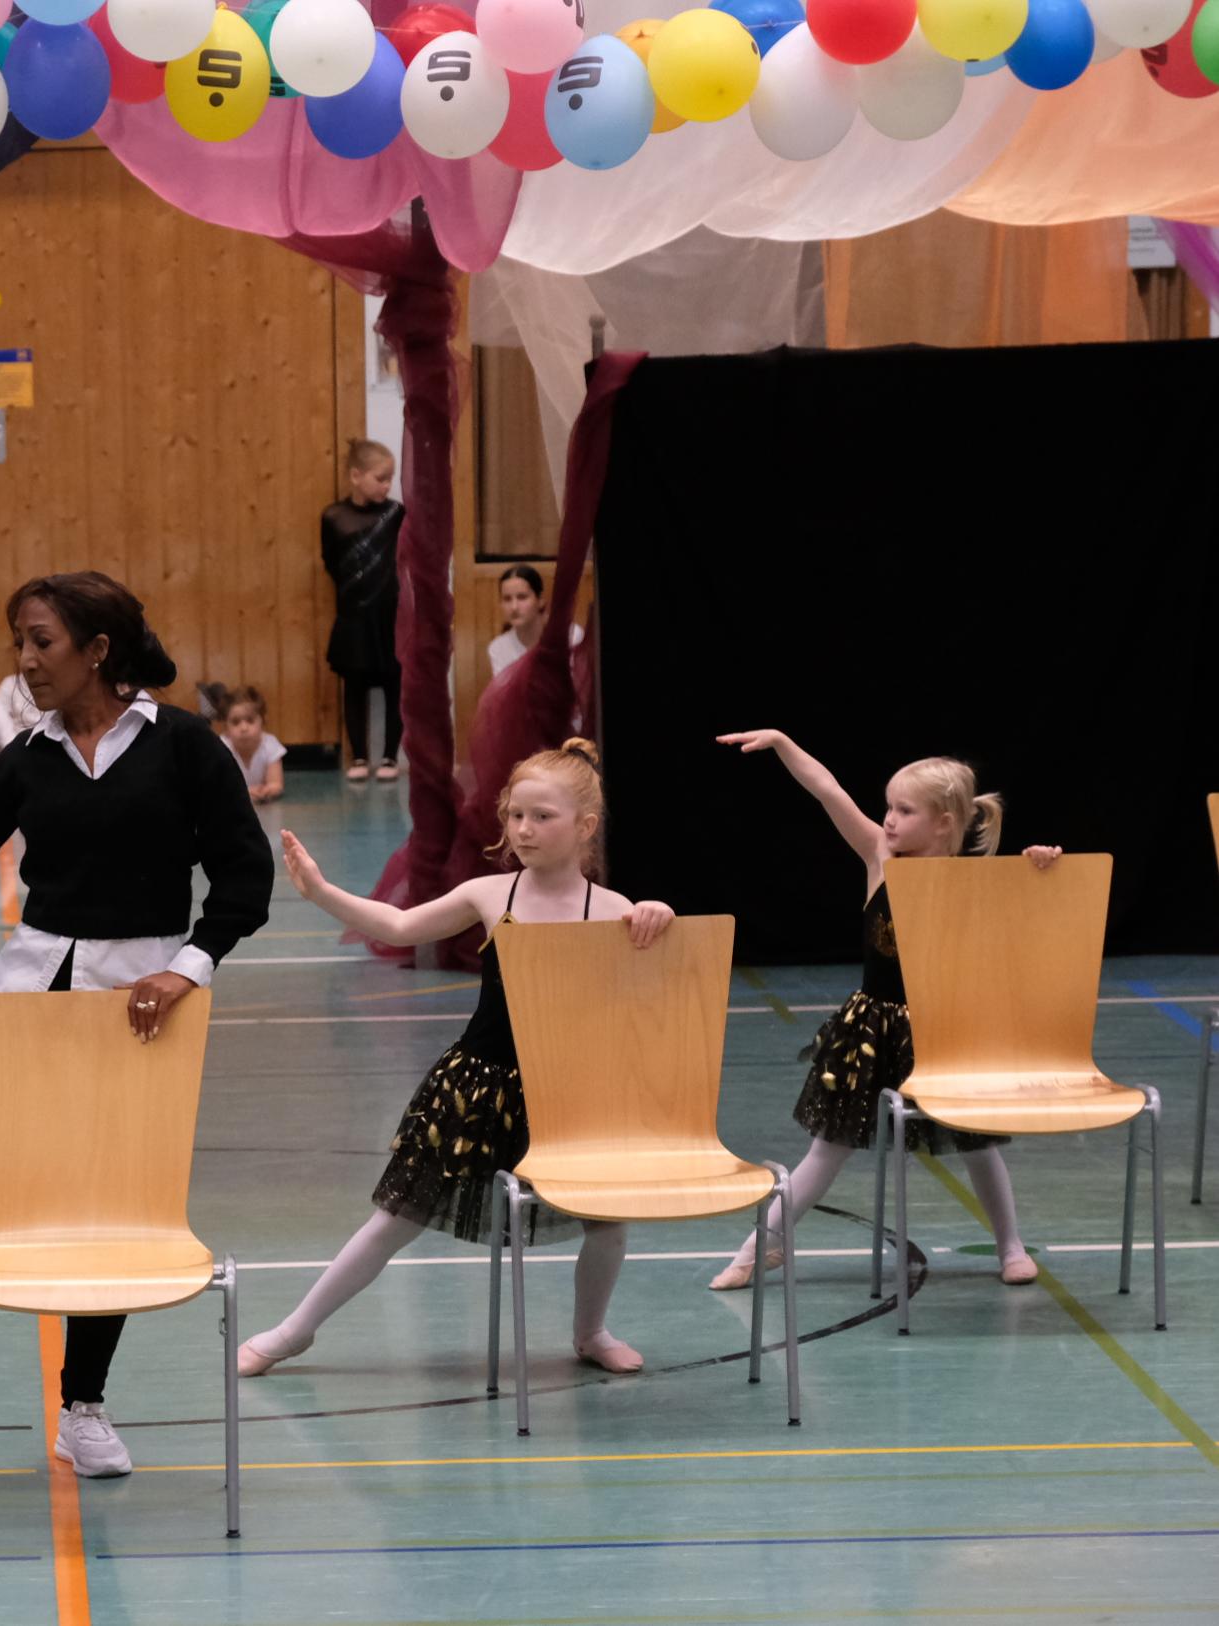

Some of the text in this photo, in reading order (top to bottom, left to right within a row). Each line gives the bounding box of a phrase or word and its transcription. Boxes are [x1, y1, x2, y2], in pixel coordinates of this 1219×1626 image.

[196, 48, 243, 89] S
[427, 50, 471, 82] S
[557, 56, 604, 93] S
